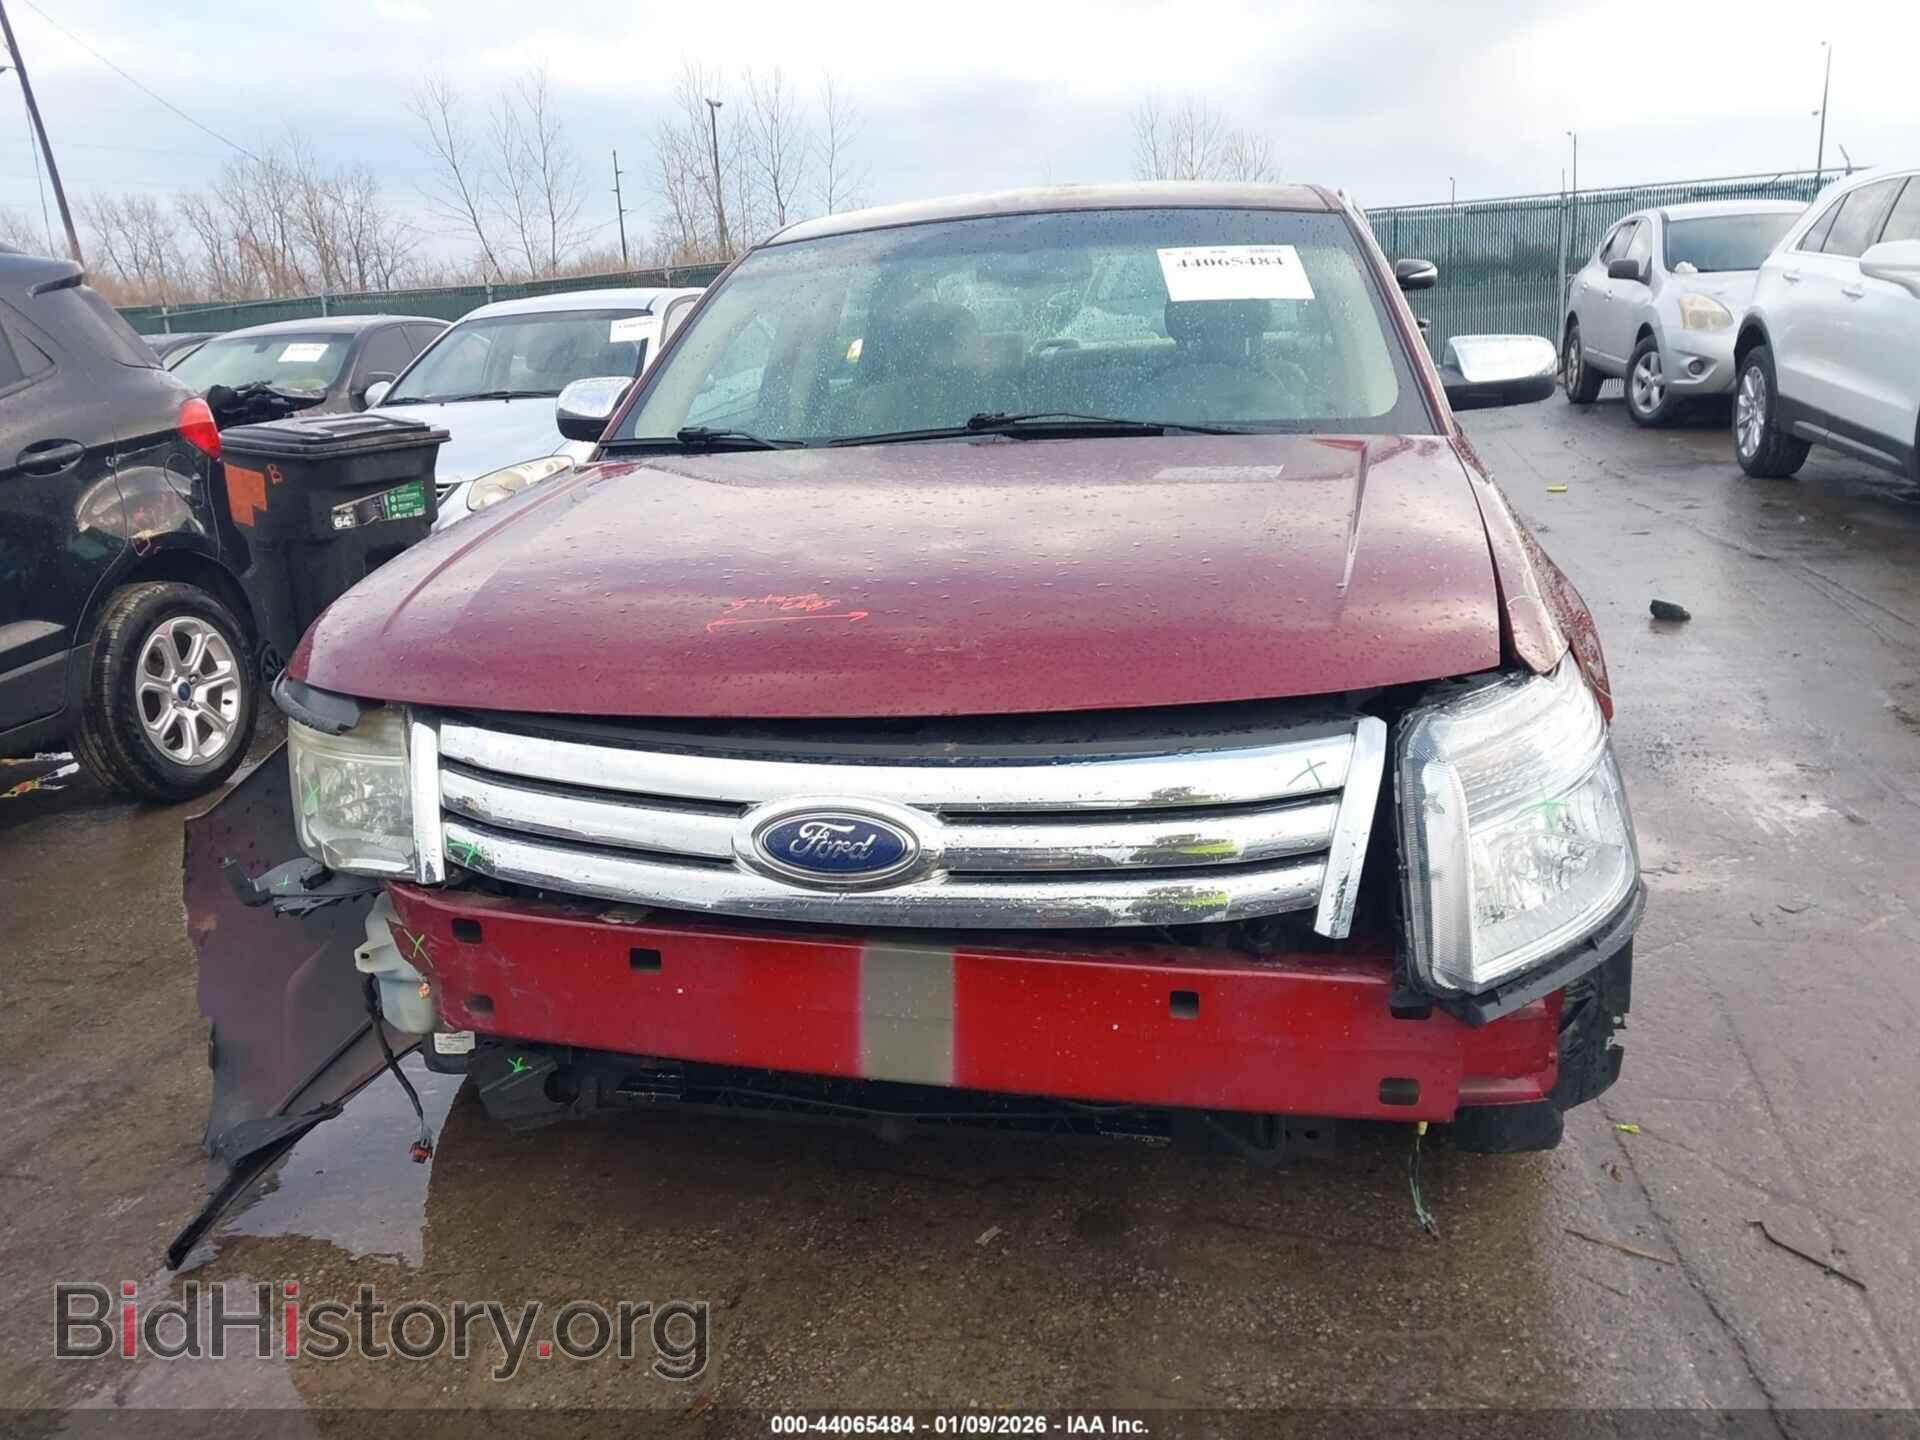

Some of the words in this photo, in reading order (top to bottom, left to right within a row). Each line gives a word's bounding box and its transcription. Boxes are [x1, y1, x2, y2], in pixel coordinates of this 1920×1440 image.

[1177, 256, 1284, 268] 44065484
[333, 515, 352, 528] 64
[789, 821, 876, 859] Ford
